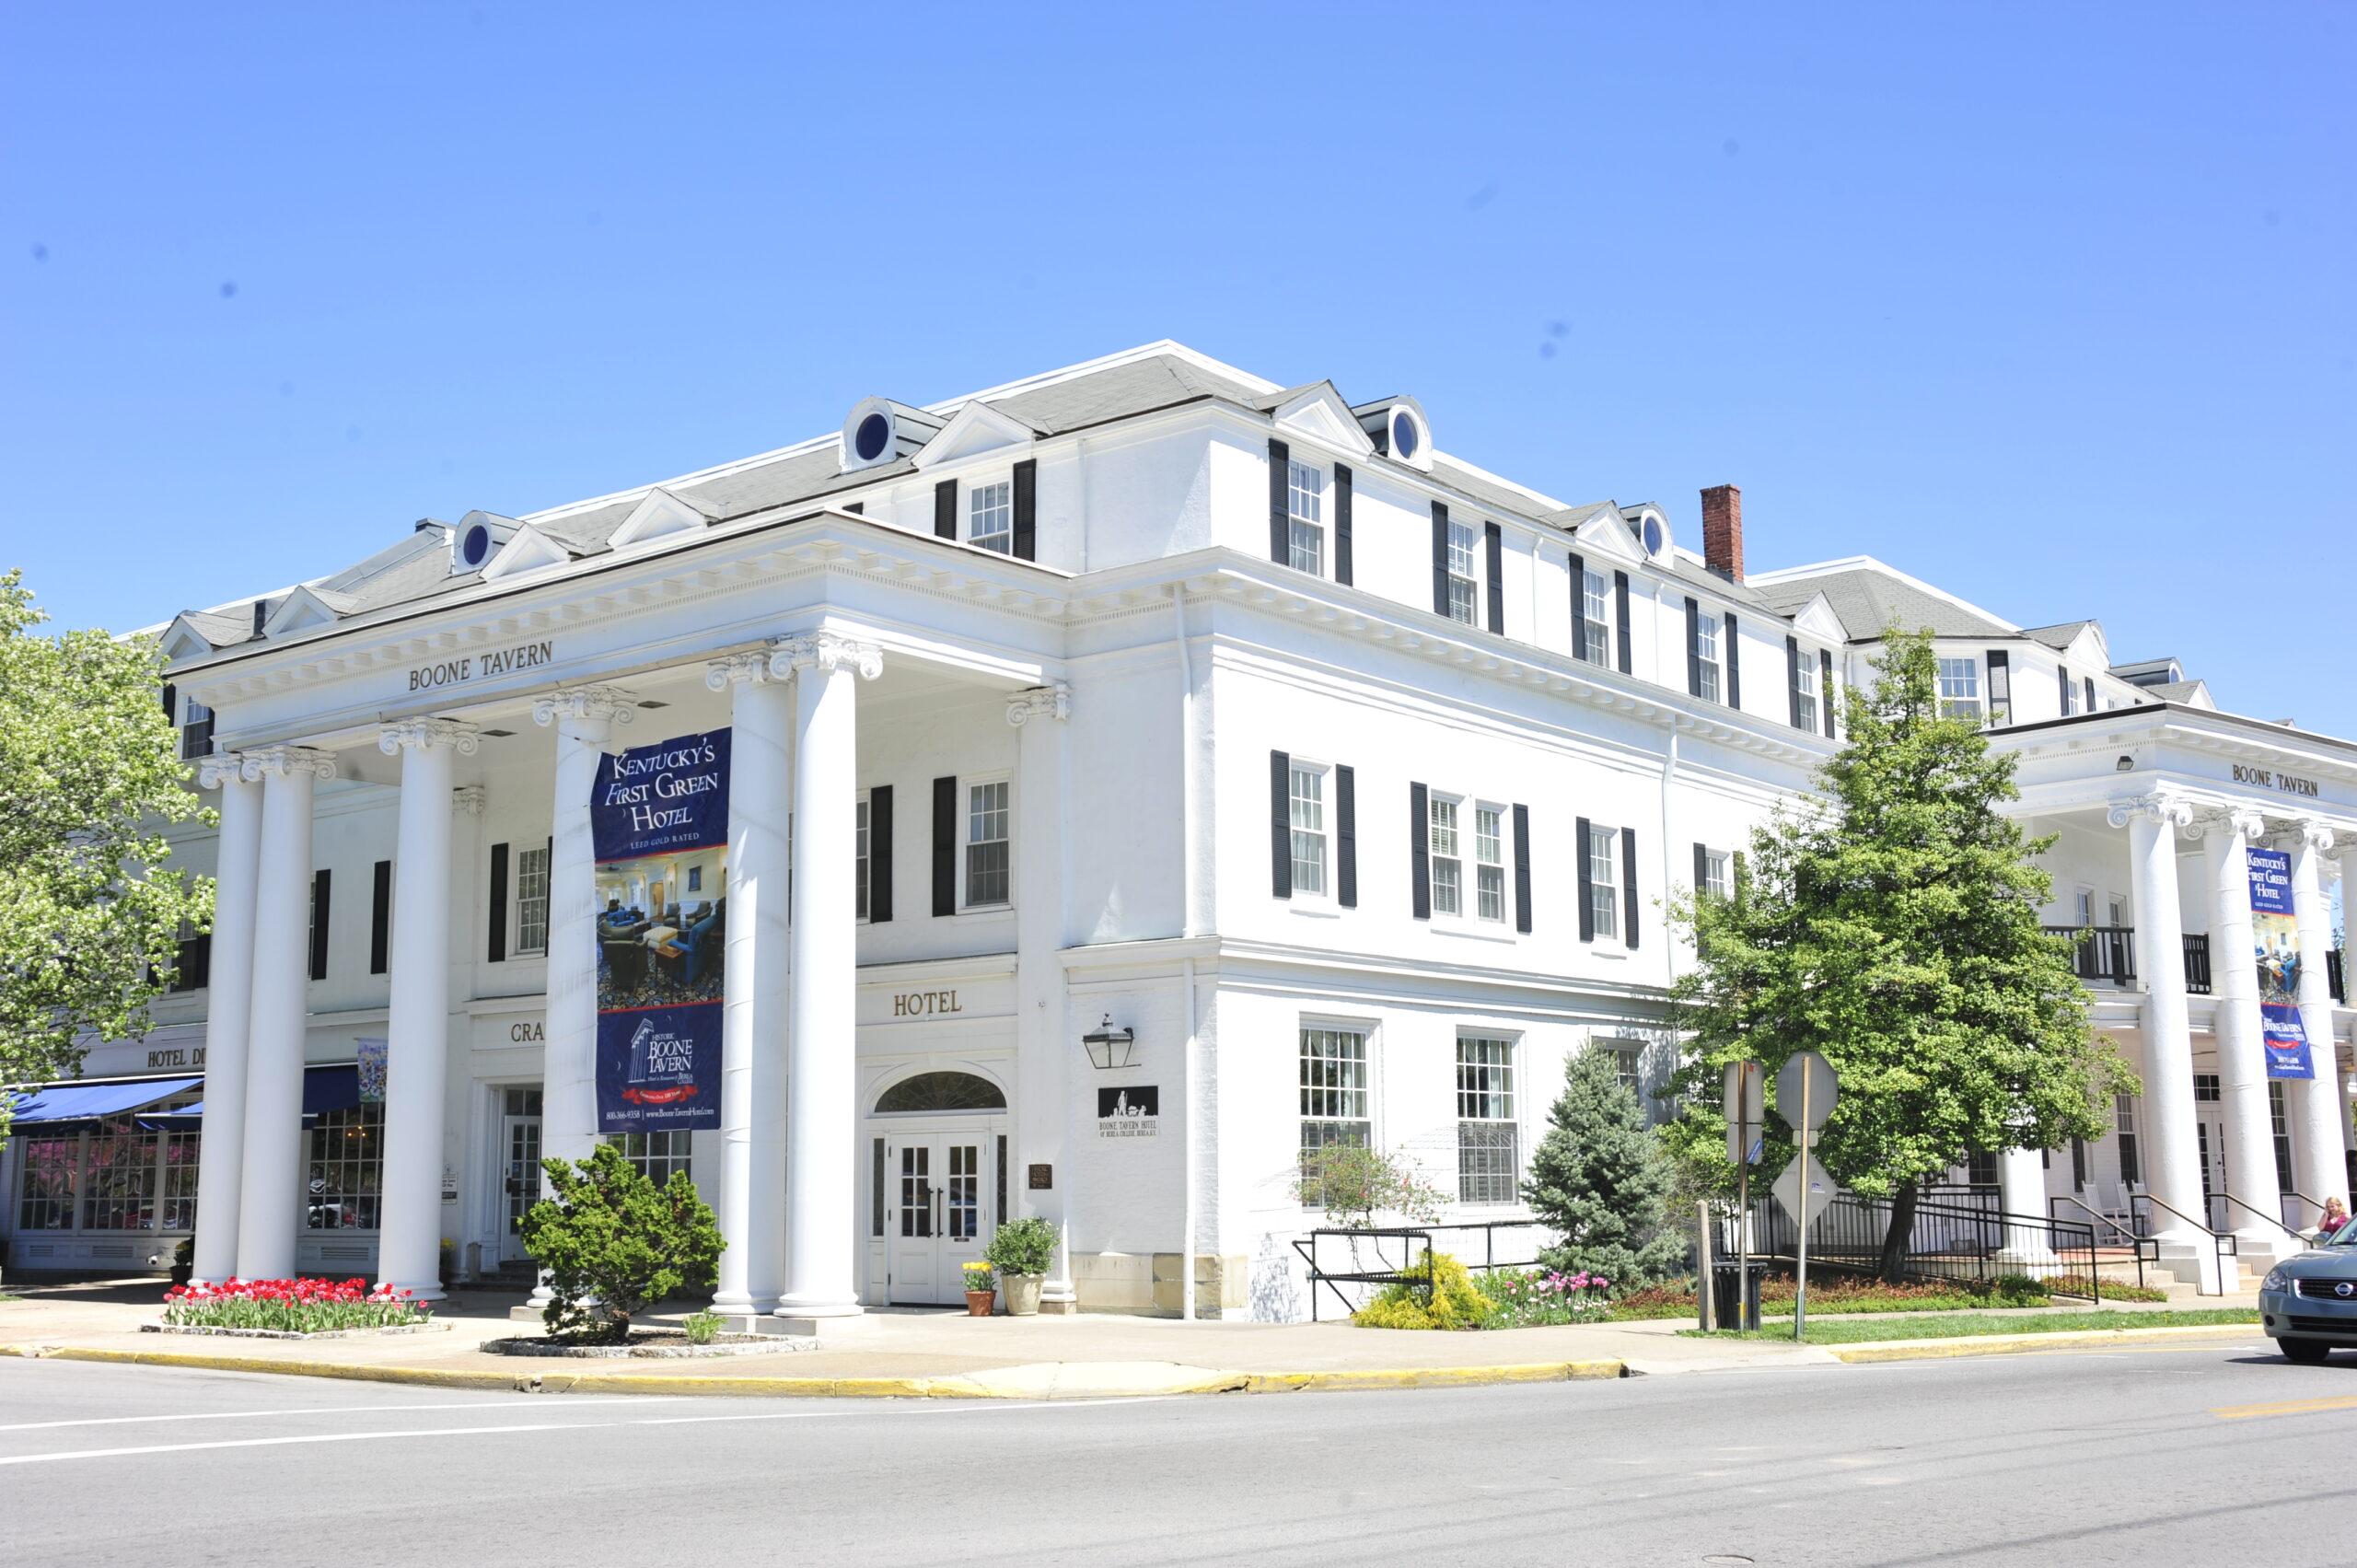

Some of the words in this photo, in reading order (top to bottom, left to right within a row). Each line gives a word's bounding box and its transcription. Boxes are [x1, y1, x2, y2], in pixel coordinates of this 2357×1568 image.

[410, 658, 470, 691] BOONE
[481, 641, 552, 676] TAVERN
[613, 737, 715, 779] KENTUCKY'S
[605, 783, 650, 806] FIRST
[656, 772, 718, 798] GREEN
[2233, 764, 2271, 787] BOONE
[2277, 773, 2318, 796] TAVERN
[630, 805, 692, 831] HOTEL
[631, 840, 649, 849] LEED
[651, 836, 669, 846] GOLD
[672, 832, 700, 842] RATED
[2247, 852, 2286, 871] KENTUCKY'S
[2266, 869, 2288, 885] GREEN
[2257, 883, 2281, 899] HOTEL
[894, 990, 962, 1016] HOTEL
[148, 1049, 187, 1067] HOTEL
[649, 1040, 692, 1058] BOONE
[647, 1056, 692, 1073] TAVERN
[1099, 1121, 1117, 1130] BOONE
[1119, 1121, 1139, 1130] TAVERN
[1141, 1120, 1157, 1129] HOTEL
